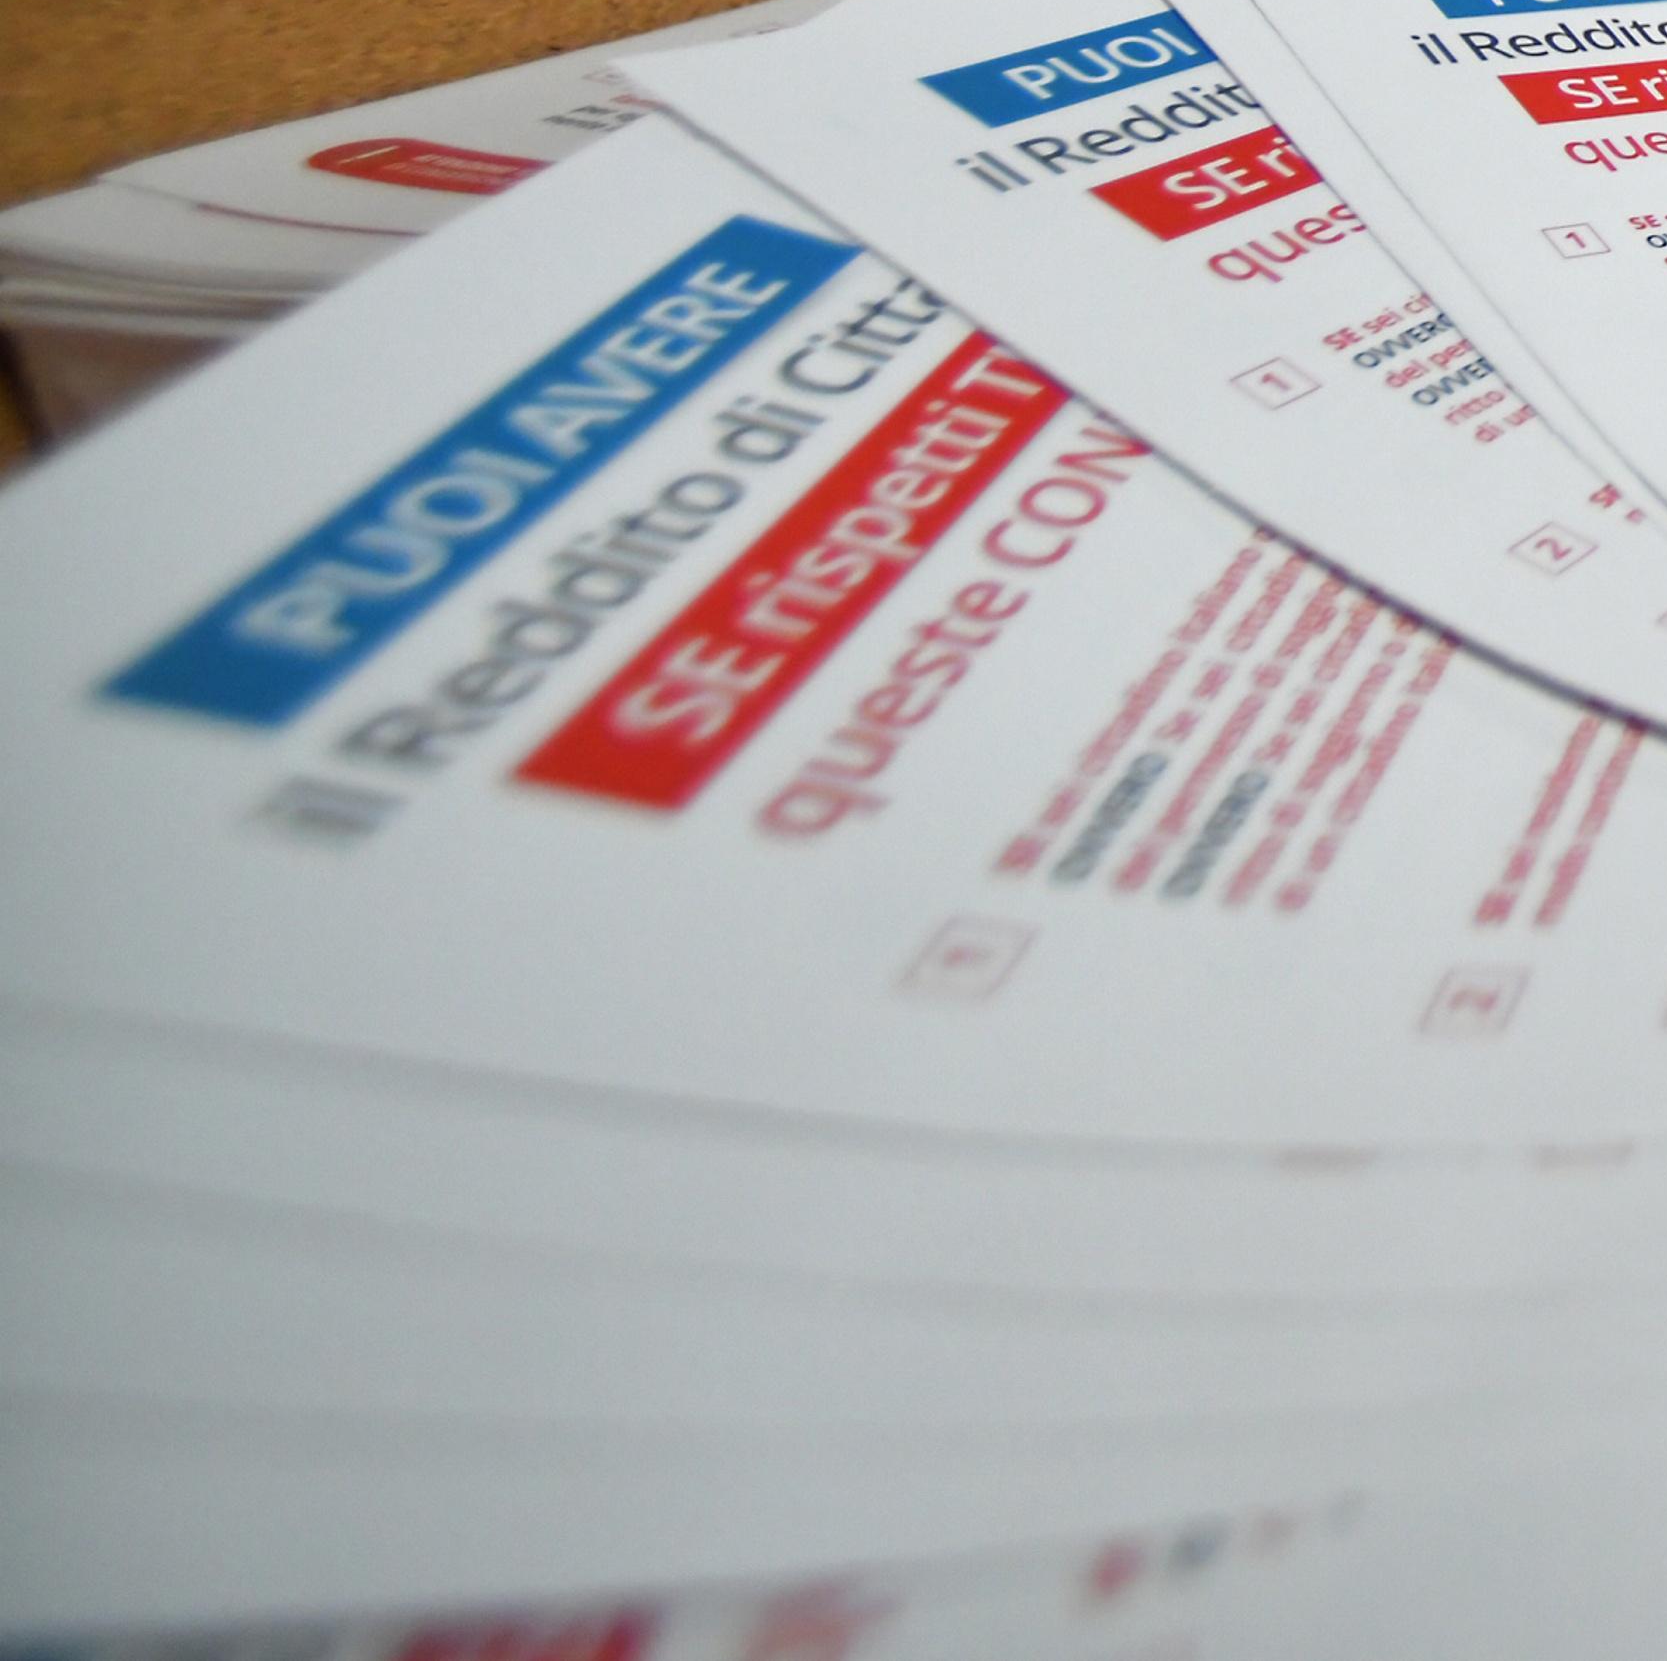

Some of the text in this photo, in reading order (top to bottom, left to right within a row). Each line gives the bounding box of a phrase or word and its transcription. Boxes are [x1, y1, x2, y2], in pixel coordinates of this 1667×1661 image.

[1001, 27, 1201, 101] PUOI
[1410, 32, 1459, 65] il
[1556, 75, 1640, 110] SE
[955, 150, 1034, 193] il
[1161, 156, 1255, 211] SE
[1565, 231, 1588, 250] 1
[1627, 213, 1663, 232] SE
[1322, 327, 1365, 352] SE
[232, 443, 554, 657] PUOI
[511, 259, 791, 463] AVERE
[335, 466, 746, 773] Reddito
[713, 390, 831, 469] di
[609, 632, 783, 746] SE
[737, 385, 1014, 643] rispetti
[753, 578, 1030, 842] queste
